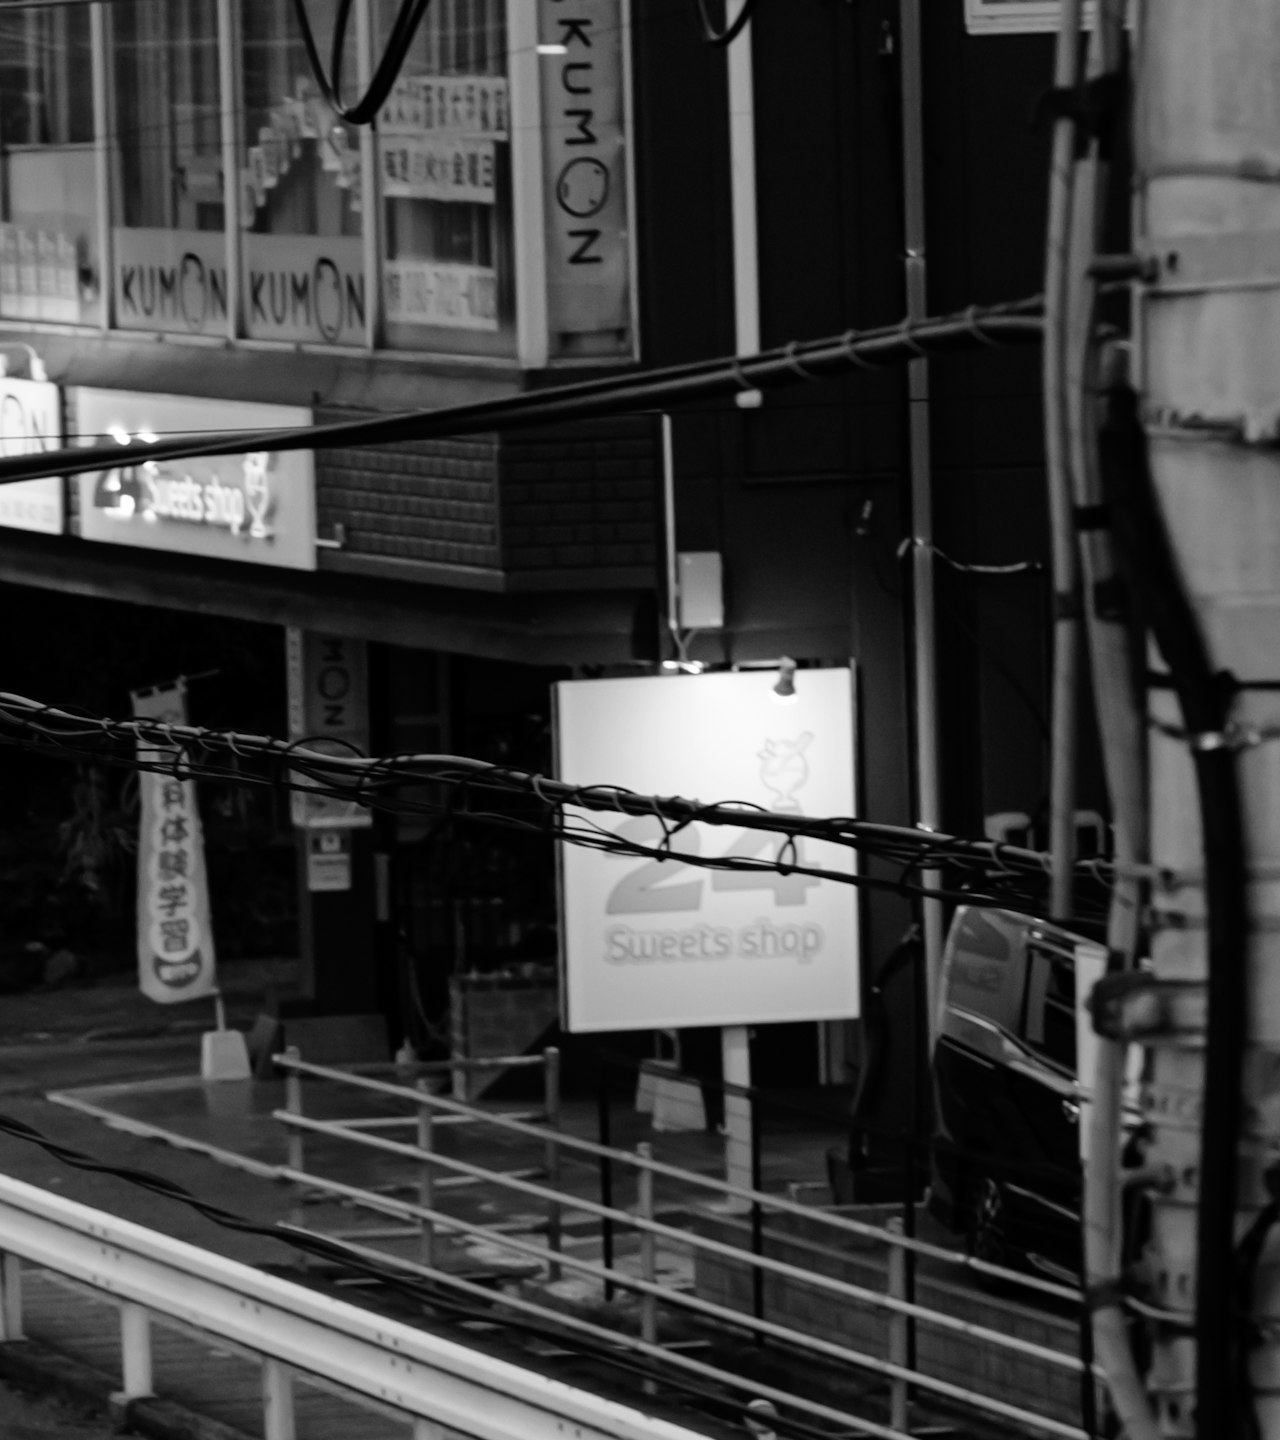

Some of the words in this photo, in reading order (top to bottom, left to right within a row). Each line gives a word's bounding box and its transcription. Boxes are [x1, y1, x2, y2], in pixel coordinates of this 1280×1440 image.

[556, 19, 611, 265] KUMON
[121, 251, 229, 333] KUMON
[250, 256, 366, 343] KUMON
[603, 810, 822, 916] 24
[605, 925, 733, 962] Sweets
[740, 919, 825, 963] shop
